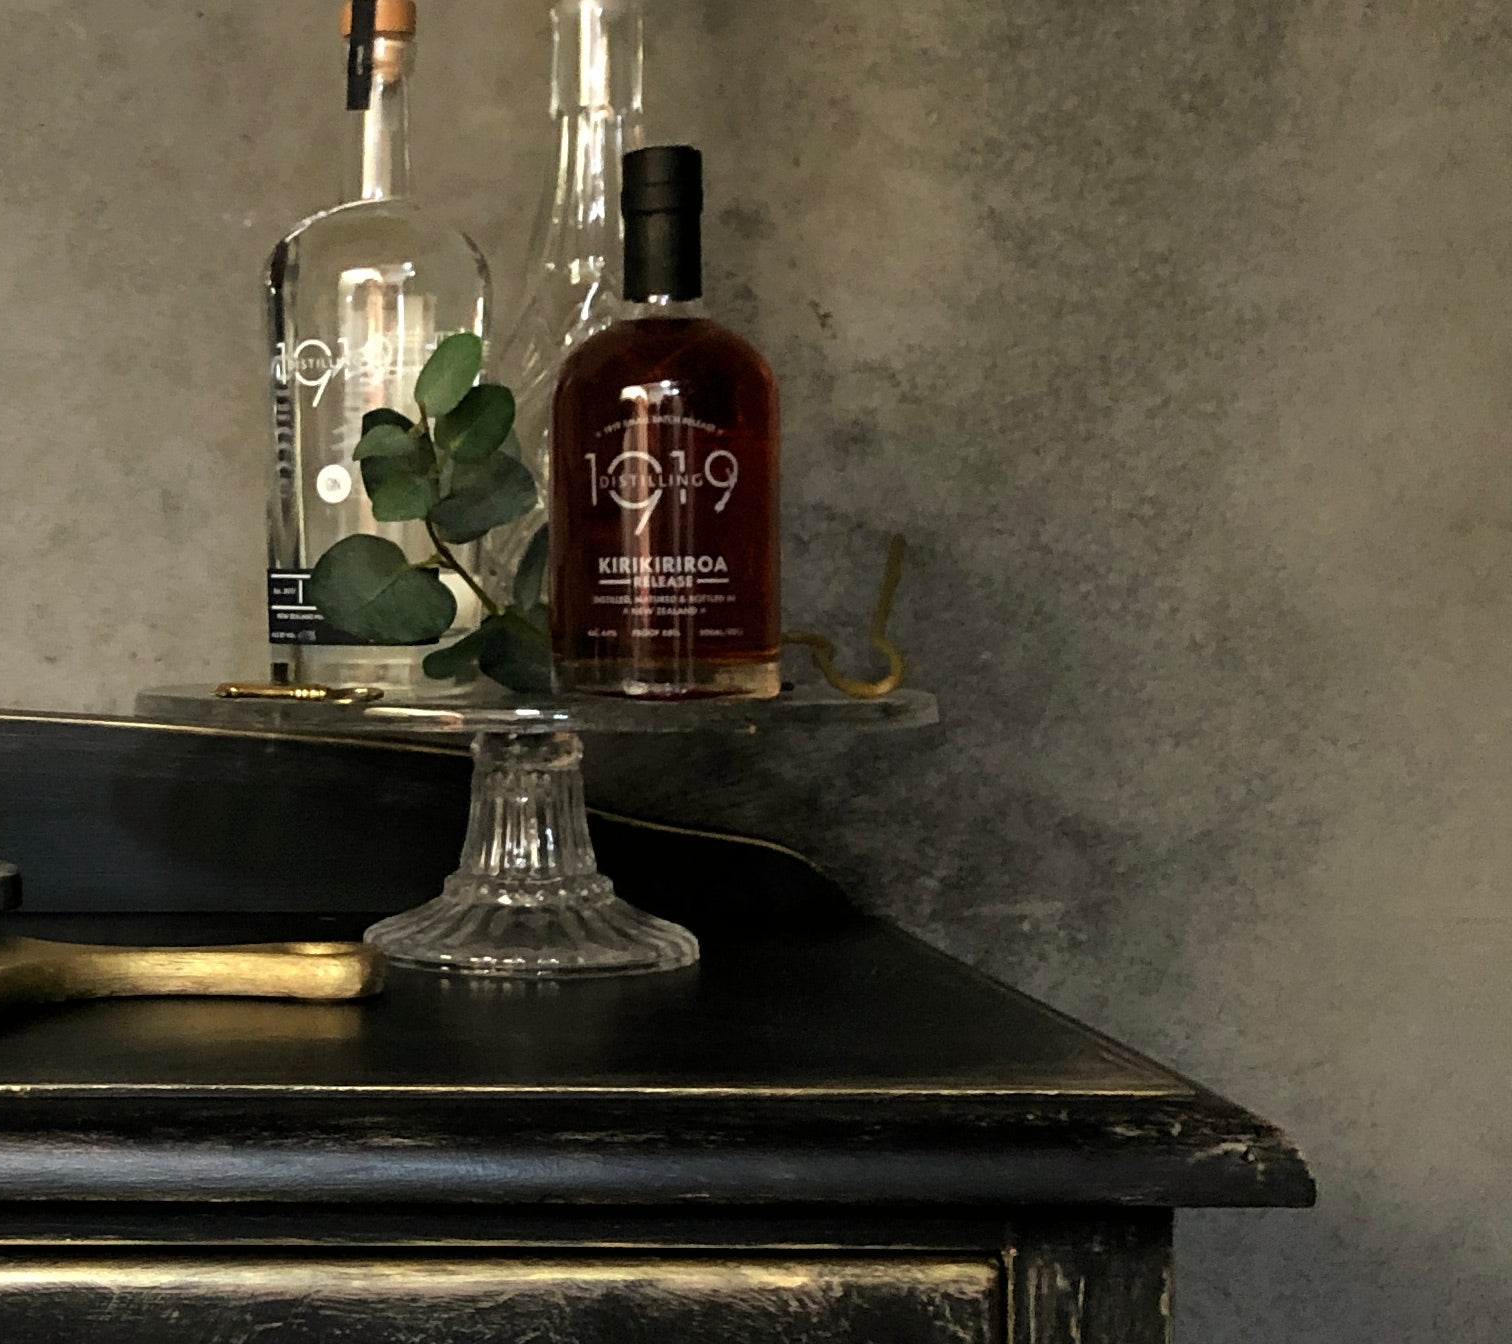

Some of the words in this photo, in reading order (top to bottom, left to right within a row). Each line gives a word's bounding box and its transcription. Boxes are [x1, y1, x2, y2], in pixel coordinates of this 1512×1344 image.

[599, 471, 704, 490] DISTILLING
[584, 449, 738, 535] 1919
[598, 555, 728, 574] KIRIKIRIROA
[633, 575, 693, 588] RELEASE
